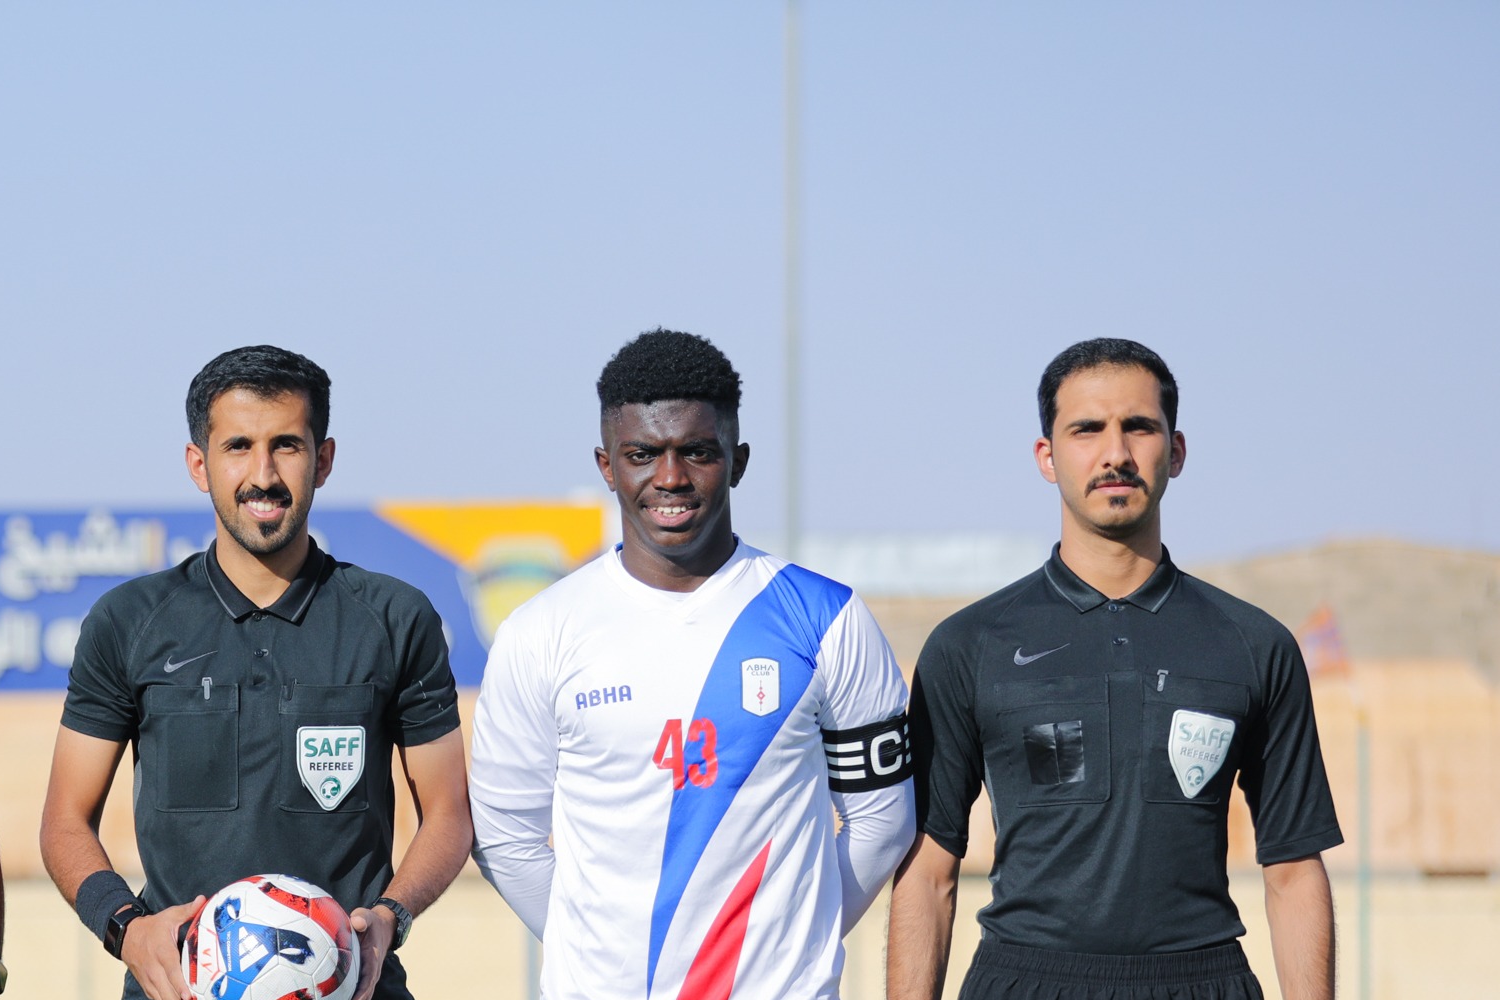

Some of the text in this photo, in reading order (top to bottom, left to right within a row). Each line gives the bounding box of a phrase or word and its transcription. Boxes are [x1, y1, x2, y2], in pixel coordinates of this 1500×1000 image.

[575, 685, 632, 710] ABHA
[1179, 721, 1231, 749] SAFF
[304, 737, 360, 757] SAFF
[652, 717, 719, 790] 43
[1180, 747, 1220, 763] REFEREE
[309, 762, 354, 771] REFEREE
